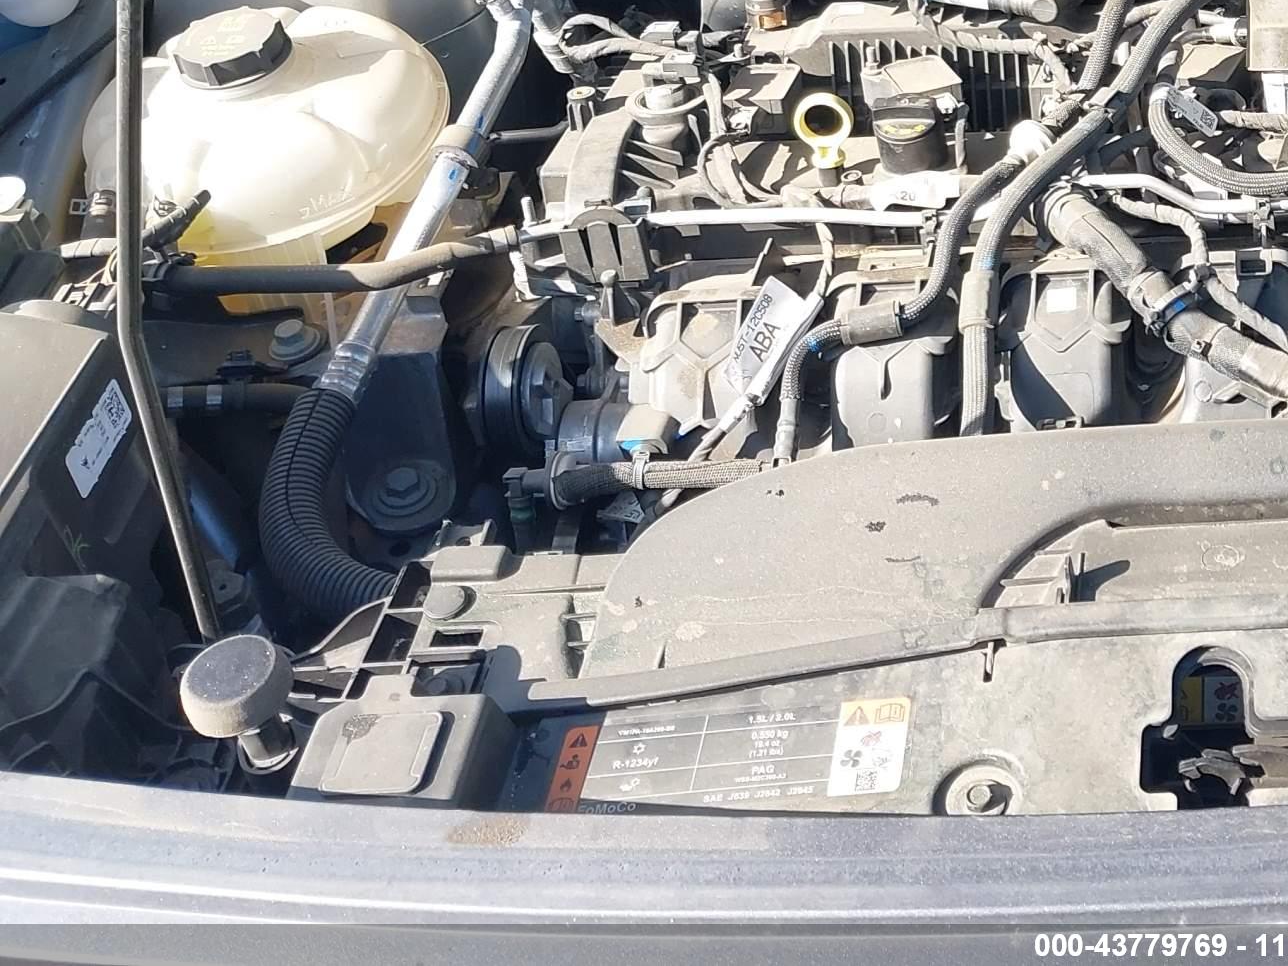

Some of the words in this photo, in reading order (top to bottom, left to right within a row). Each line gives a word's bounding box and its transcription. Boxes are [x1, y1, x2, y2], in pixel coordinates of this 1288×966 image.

[748, 321, 782, 363] ABA
[775, 713, 796, 722] 2.0L
[777, 729, 789, 739] kg
[612, 756, 660, 770] R-1234yf
[751, 764, 775, 775] PAG
[703, 794, 724, 803] SAE
[577, 801, 637, 814] FoMoCo
